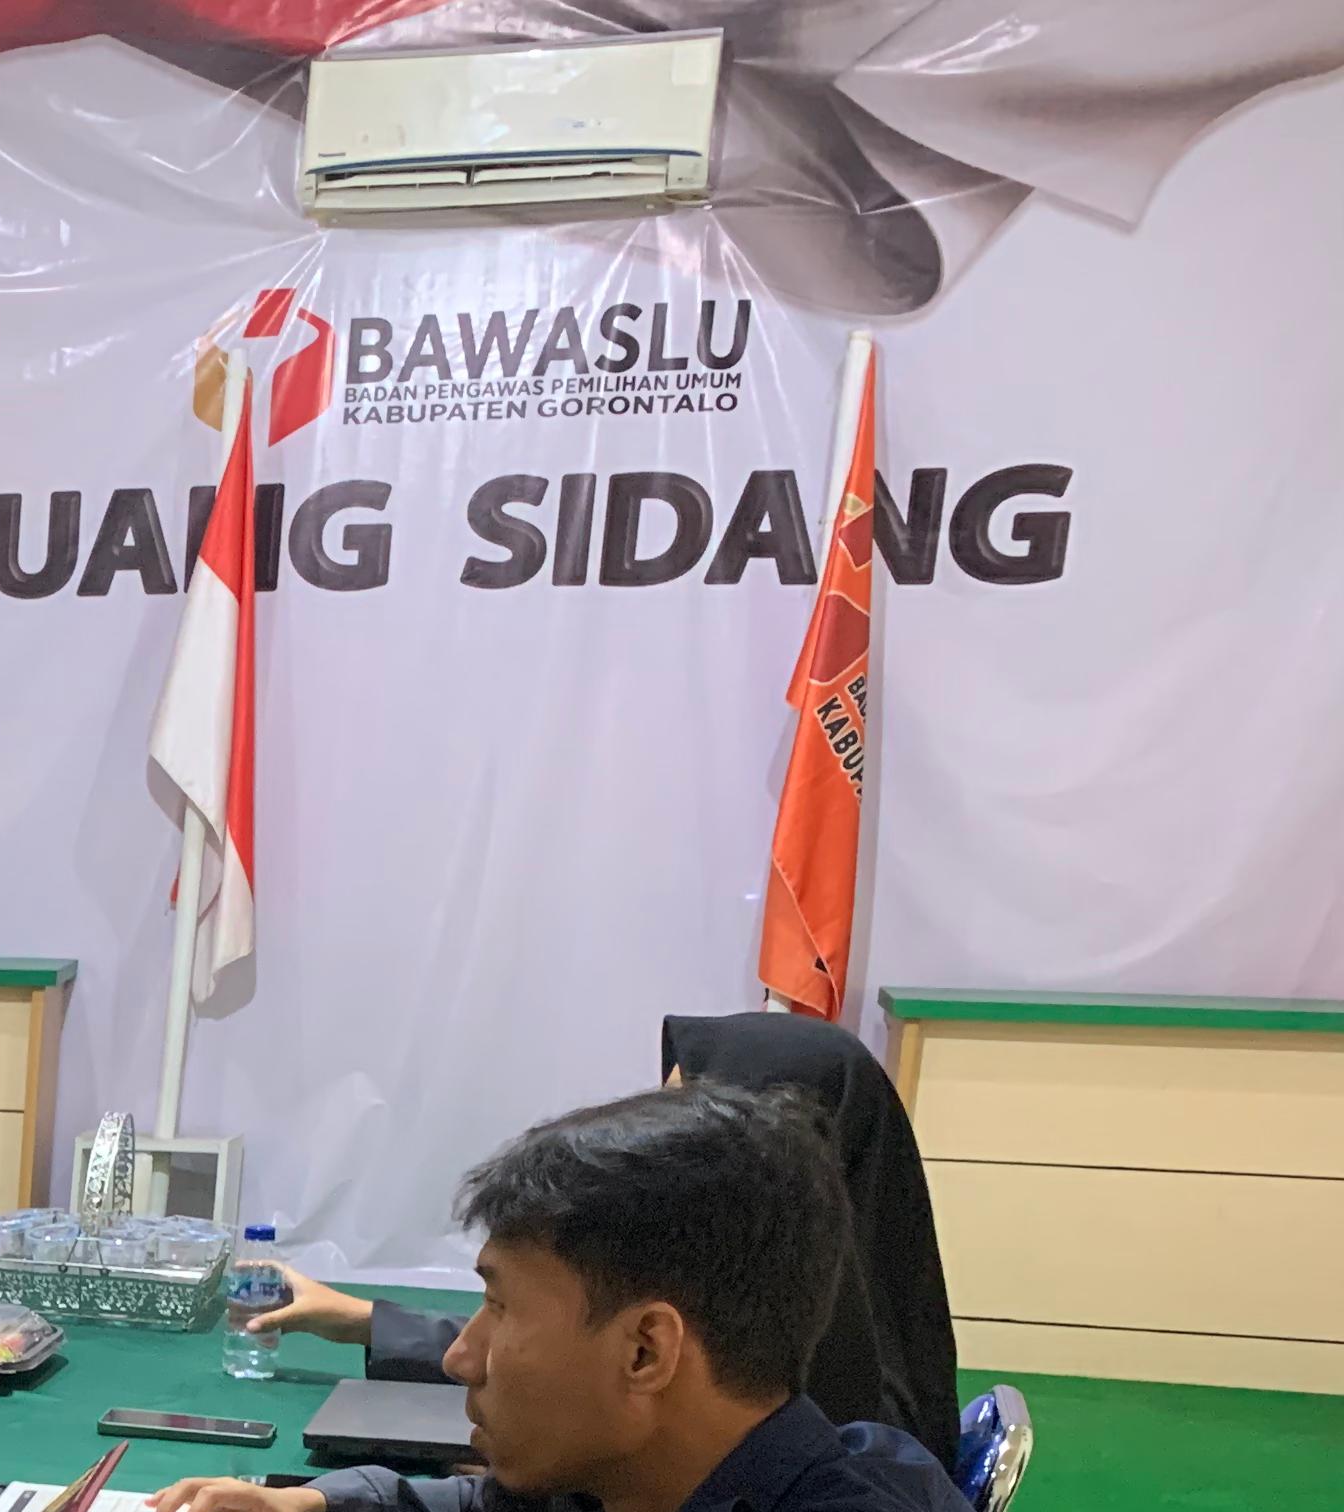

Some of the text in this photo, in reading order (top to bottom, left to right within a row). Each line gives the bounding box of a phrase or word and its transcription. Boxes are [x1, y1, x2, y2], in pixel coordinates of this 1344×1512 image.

[347, 300, 751, 385] BAWASLU
[343, 393, 738, 425] KABUPATEN GORONTALO
[345, 372, 741, 403] BADAN PENGAWAS PEMILIHAN UMUM
[459, 463, 1073, 589] SIDANG
